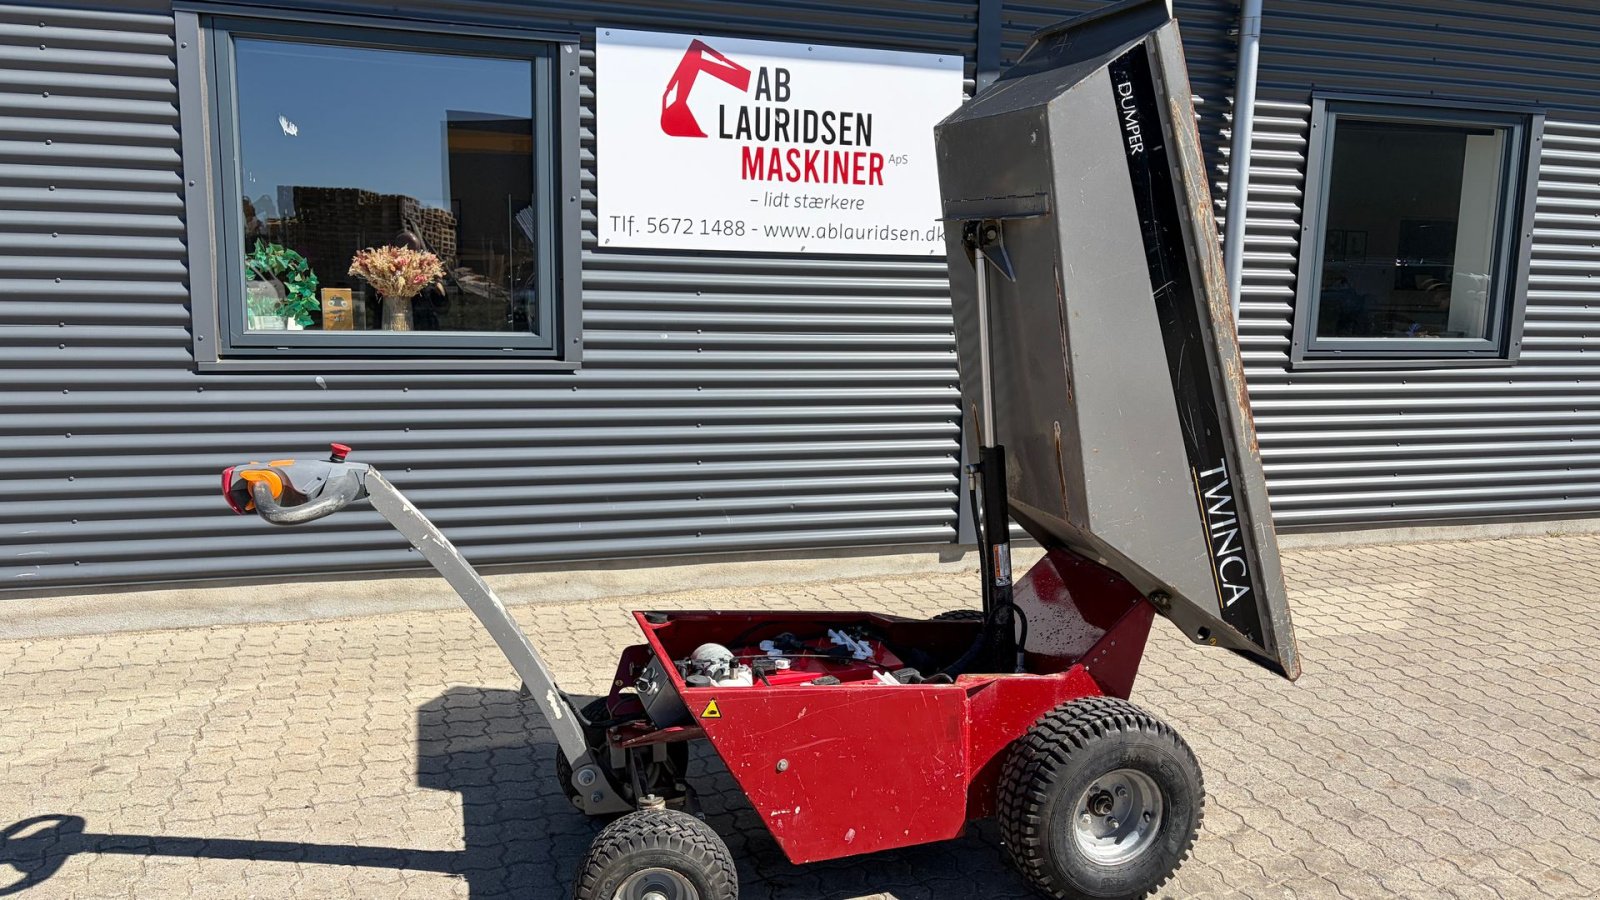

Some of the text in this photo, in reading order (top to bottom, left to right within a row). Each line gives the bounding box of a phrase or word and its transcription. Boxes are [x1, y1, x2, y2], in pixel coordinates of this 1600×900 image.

[755, 66, 791, 102] AB
[719, 104, 873, 147] LAURIDSEN
[1117, 82, 1144, 156] DUMPER
[741, 146, 908, 186] MASKINER ApS
[764, 191, 790, 208] lidt
[794, 194, 865, 211] stærkere
[609, 215, 640, 236] Tlf.
[646, 217, 694, 235] 5672
[700, 219, 746, 237] 1488
[763, 222, 946, 242] www.ablauridsen.dk
[1200, 458, 1250, 607] TWINCA
